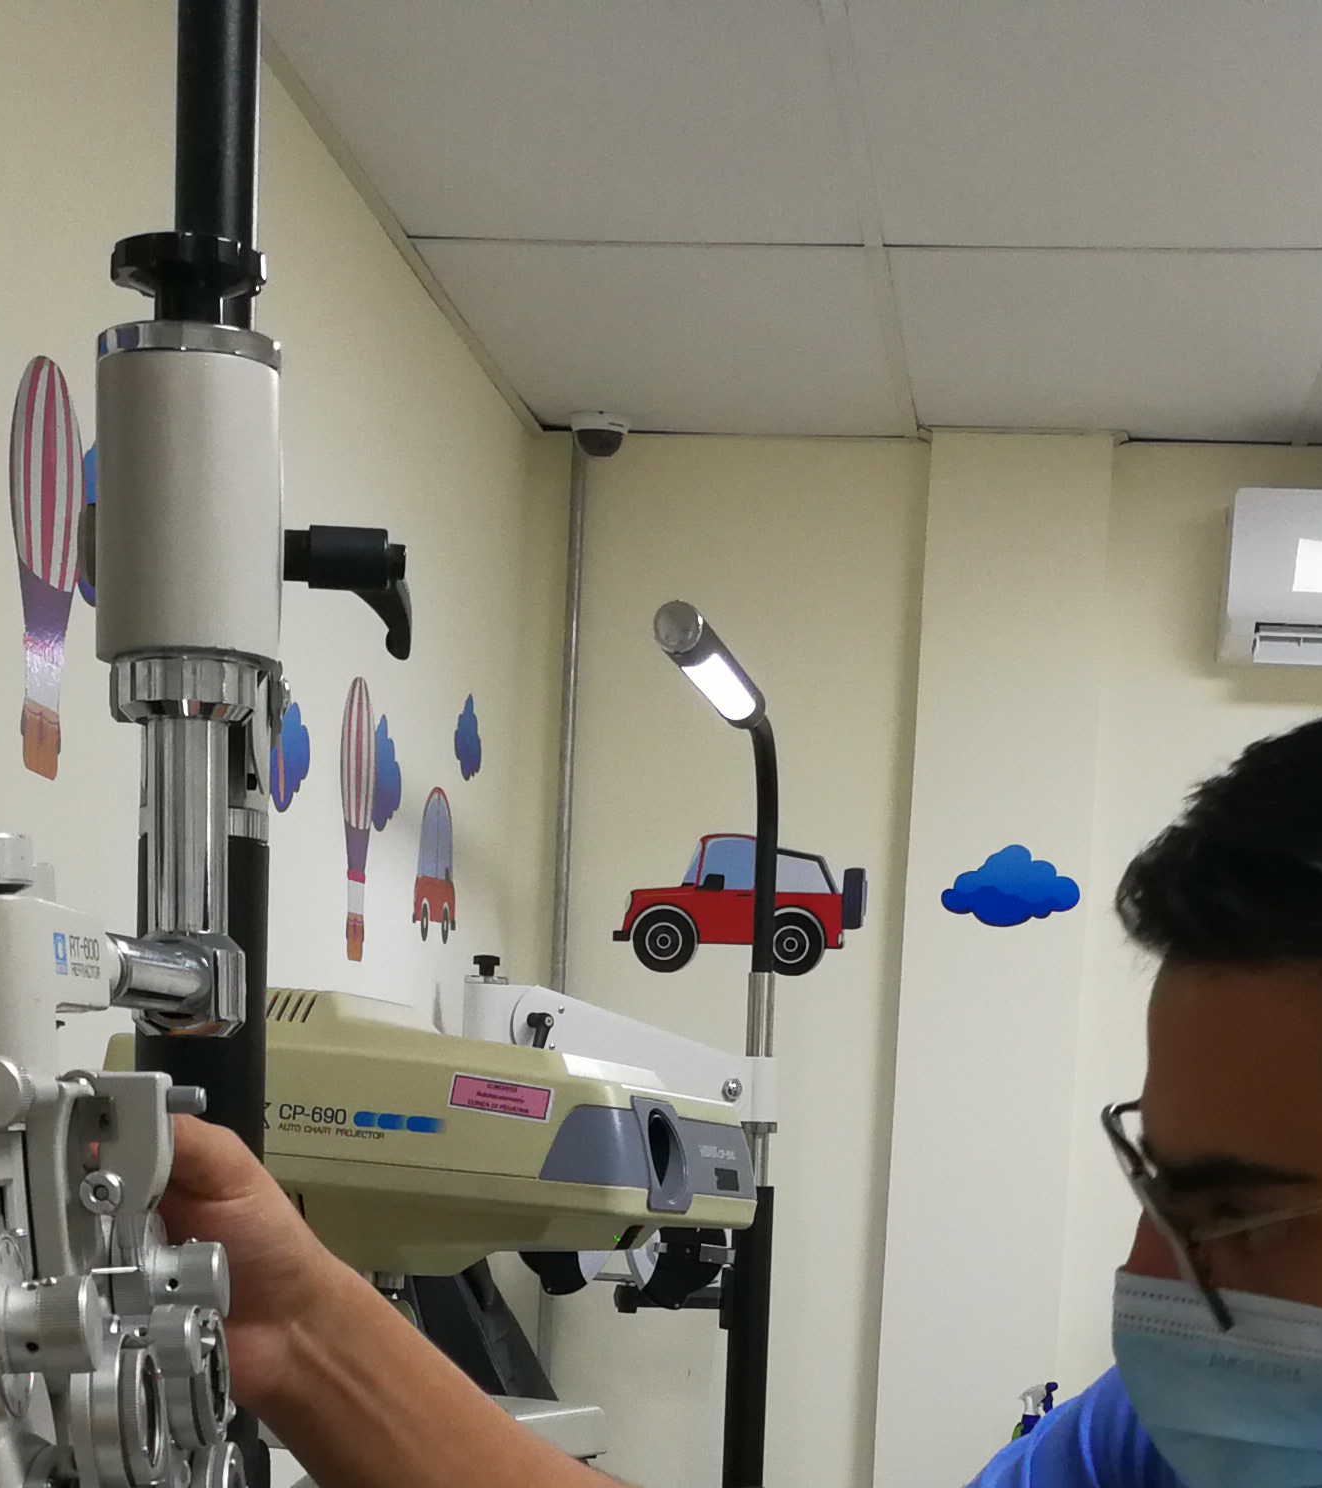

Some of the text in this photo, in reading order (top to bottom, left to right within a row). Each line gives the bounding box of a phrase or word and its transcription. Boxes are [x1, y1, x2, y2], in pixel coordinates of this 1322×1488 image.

[69, 934, 100, 961] RT-600
[278, 1103, 347, 1126] CP-690
[277, 1122, 386, 1140] AUTO CHART PROJECTOR
